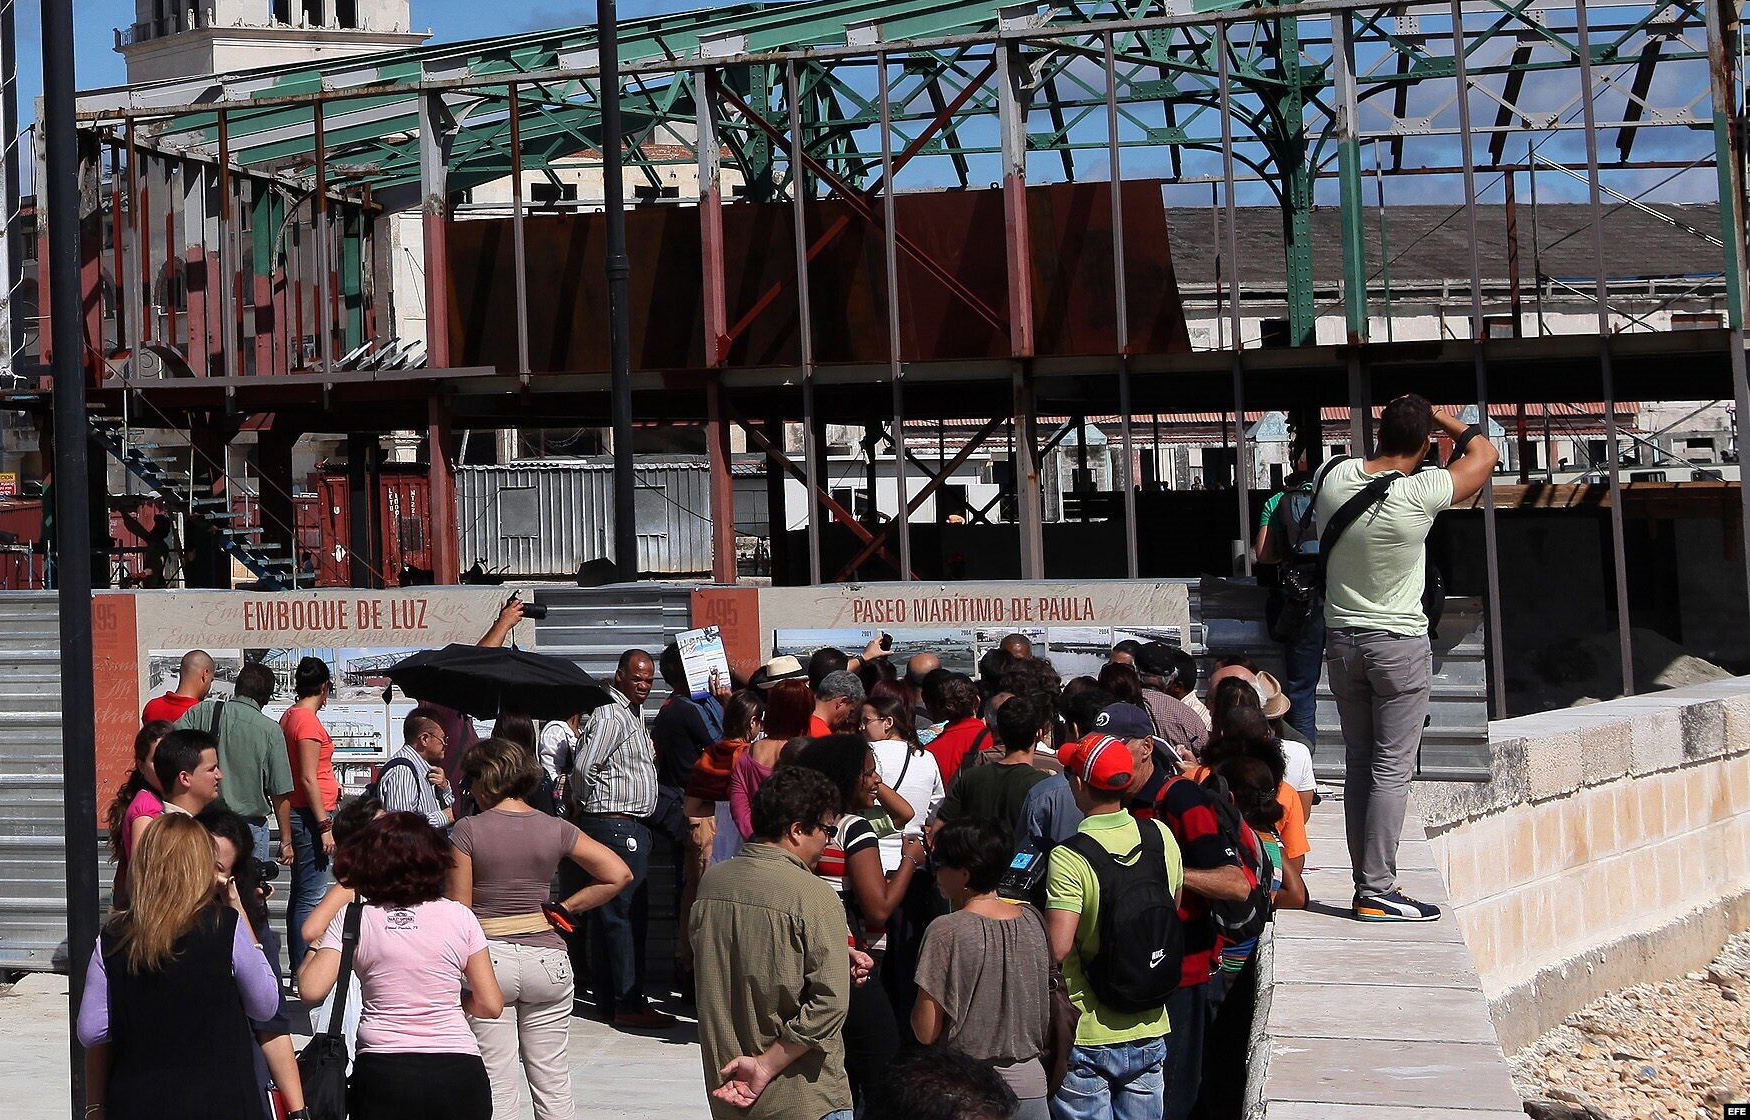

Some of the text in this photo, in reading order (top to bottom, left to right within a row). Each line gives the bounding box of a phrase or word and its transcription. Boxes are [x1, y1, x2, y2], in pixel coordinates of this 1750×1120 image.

[243, 600, 349, 631] EMBOQUE
[356, 599, 383, 630] DE
[391, 599, 429, 630] LUZ
[705, 599, 738, 626] 495
[853, 593, 1095, 623] PASEO MARÍTIMO DE PAULA
